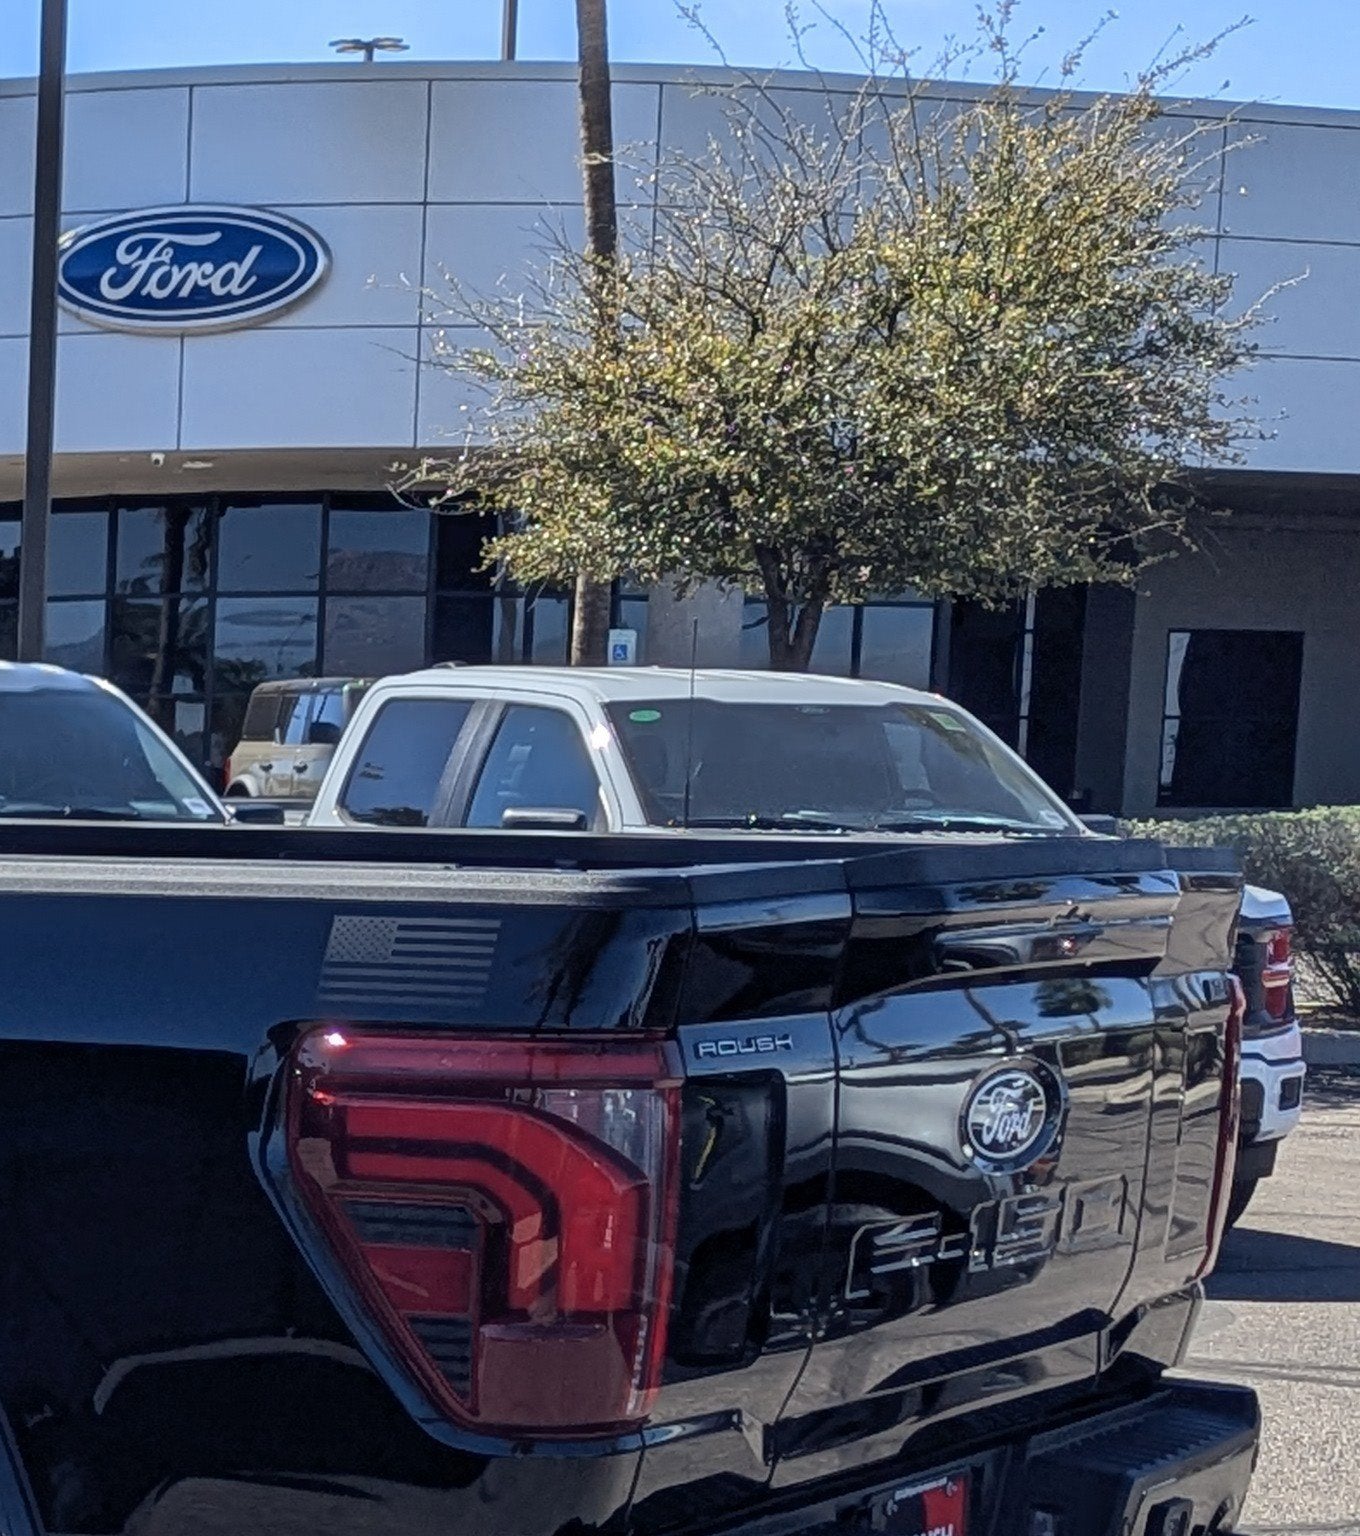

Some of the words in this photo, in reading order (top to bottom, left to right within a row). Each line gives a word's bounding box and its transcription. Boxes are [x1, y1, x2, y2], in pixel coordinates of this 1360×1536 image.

[99, 231, 264, 301] Ford
[696, 1034, 794, 1059] ROUSH
[982, 1085, 1035, 1146] Ford
